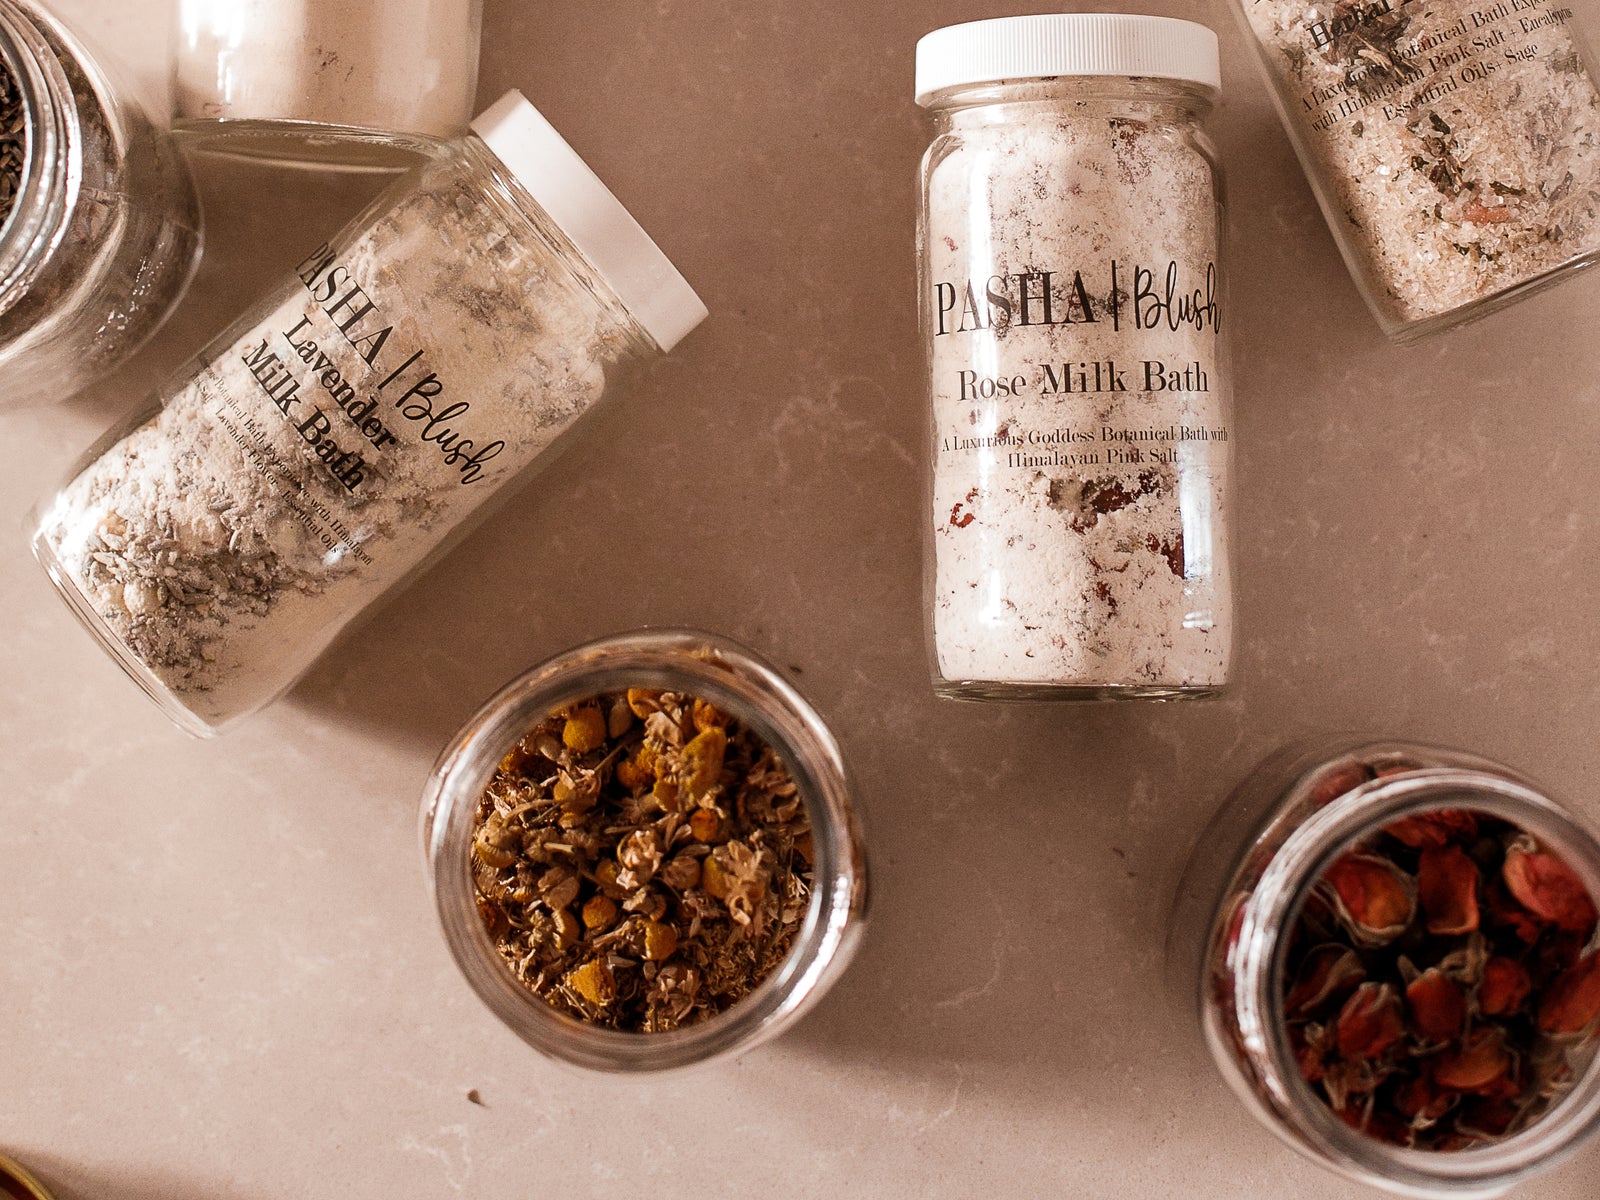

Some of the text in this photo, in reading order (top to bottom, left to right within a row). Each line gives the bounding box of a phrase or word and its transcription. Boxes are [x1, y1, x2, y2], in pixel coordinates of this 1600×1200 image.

[1311, 109, 1338, 133] with
[1338, 67, 1426, 118] Himalayan
[1427, 44, 1472, 73] Pink
[1471, 29, 1507, 53] Salt
[1519, 7, 1574, 34] Eucalyptus
[1382, 75, 1458, 121] Essential
[1504, 43, 1538, 65] Sage
[1387, 18, 1468, 66] Botanical
[1470, 2, 1510, 29] Bath
[934, 269, 1101, 337] PASHA
[1133, 259, 1222, 335] Blush
[282, 313, 398, 452] Lavender
[295, 241, 395, 372] PASHA
[395, 372, 506, 485] Blush
[956, 360, 1210, 402] Rose Milk Bath
[241, 338, 366, 495] Milk Bath
[942, 425, 1229, 452] A Luxurious Goddess Botanical Bath with
[1008, 448, 1179, 469] Himalayan Pink Salt
[214, 378, 248, 420] Botanical
[243, 418, 266, 445] Bath
[310, 498, 331, 522] with
[329, 519, 373, 566] Himalayan
[215, 406, 250, 451] Lavender
[247, 448, 280, 486] Flower
[281, 489, 324, 535] Essential
[320, 532, 340, 554] Oils
